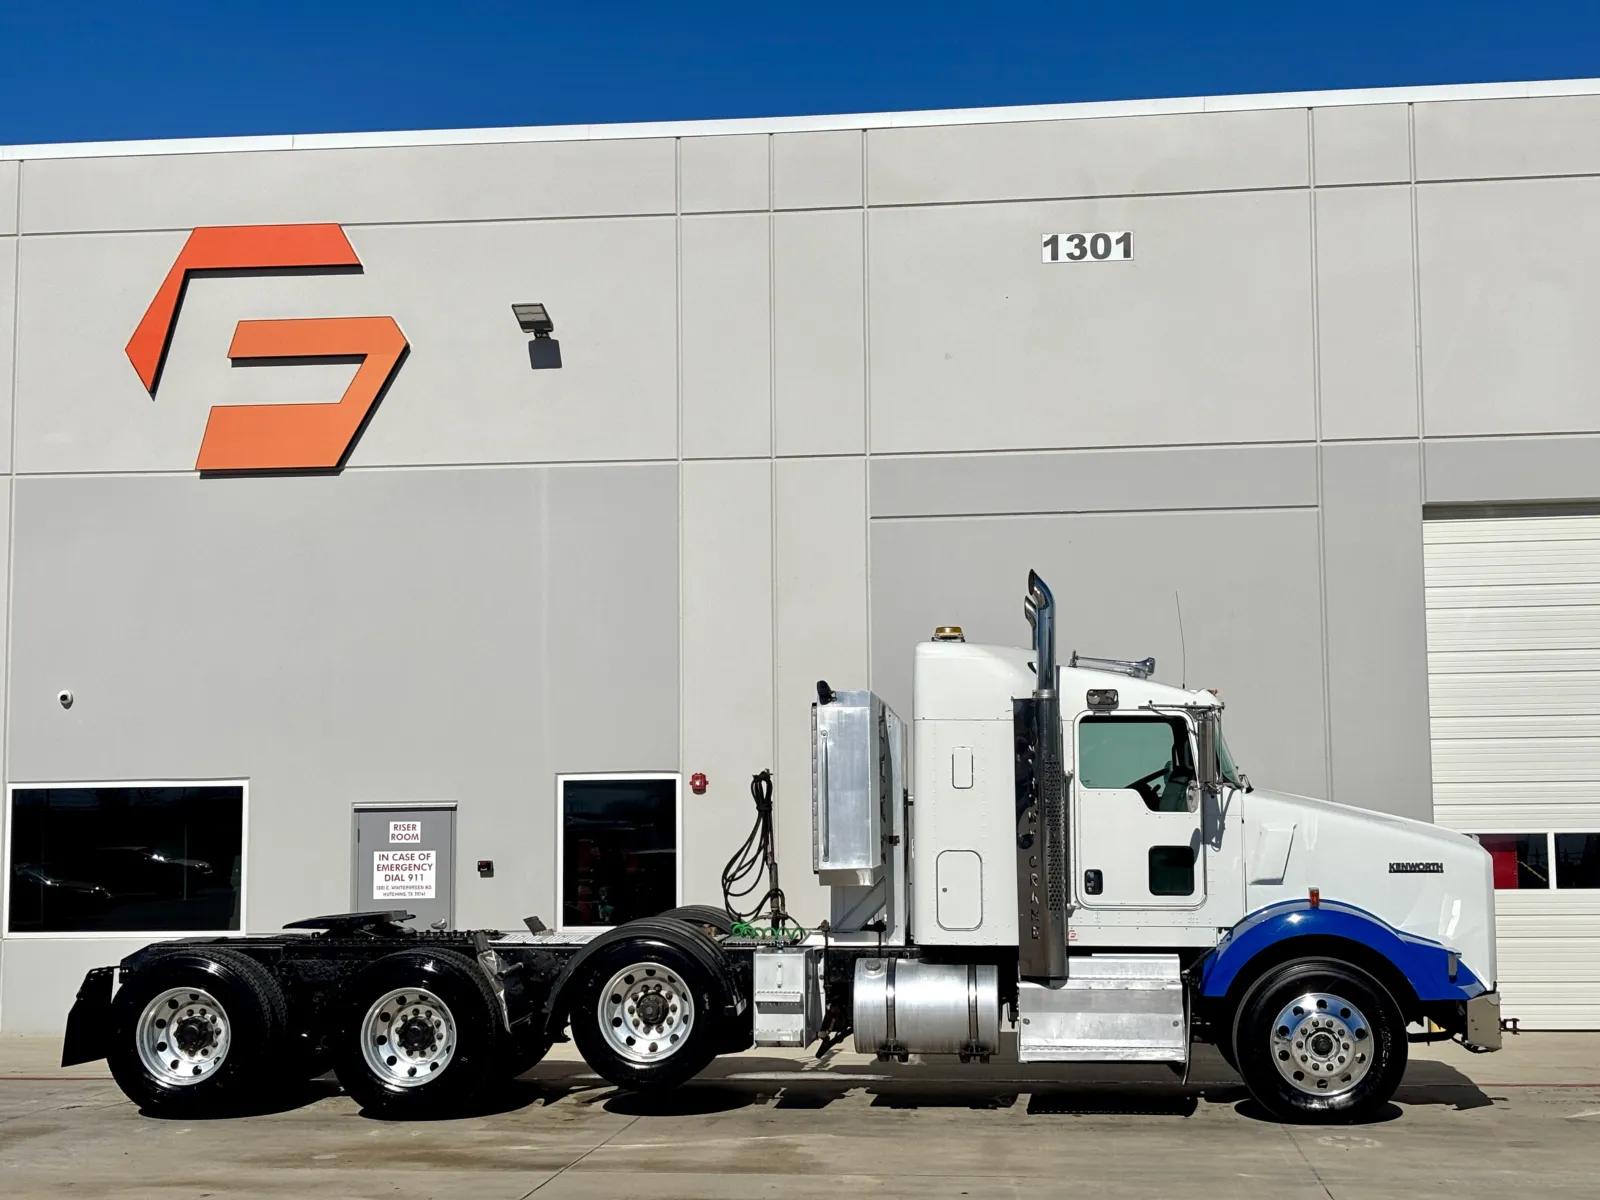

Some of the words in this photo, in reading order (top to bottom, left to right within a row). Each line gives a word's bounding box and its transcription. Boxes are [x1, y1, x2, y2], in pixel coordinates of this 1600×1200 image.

[1043, 231, 1132, 261] 1301
[393, 823, 417, 832] RISER
[390, 833, 419, 841] ROOM
[378, 853, 389, 862] IN
[392, 853, 415, 861] CASE
[418, 852, 431, 861] OF
[376, 863, 433, 872] EMERGENCY
[1389, 862, 1444, 873] KENWORTH
[384, 873, 405, 882] DIAL
[408, 873, 424, 882] 911
